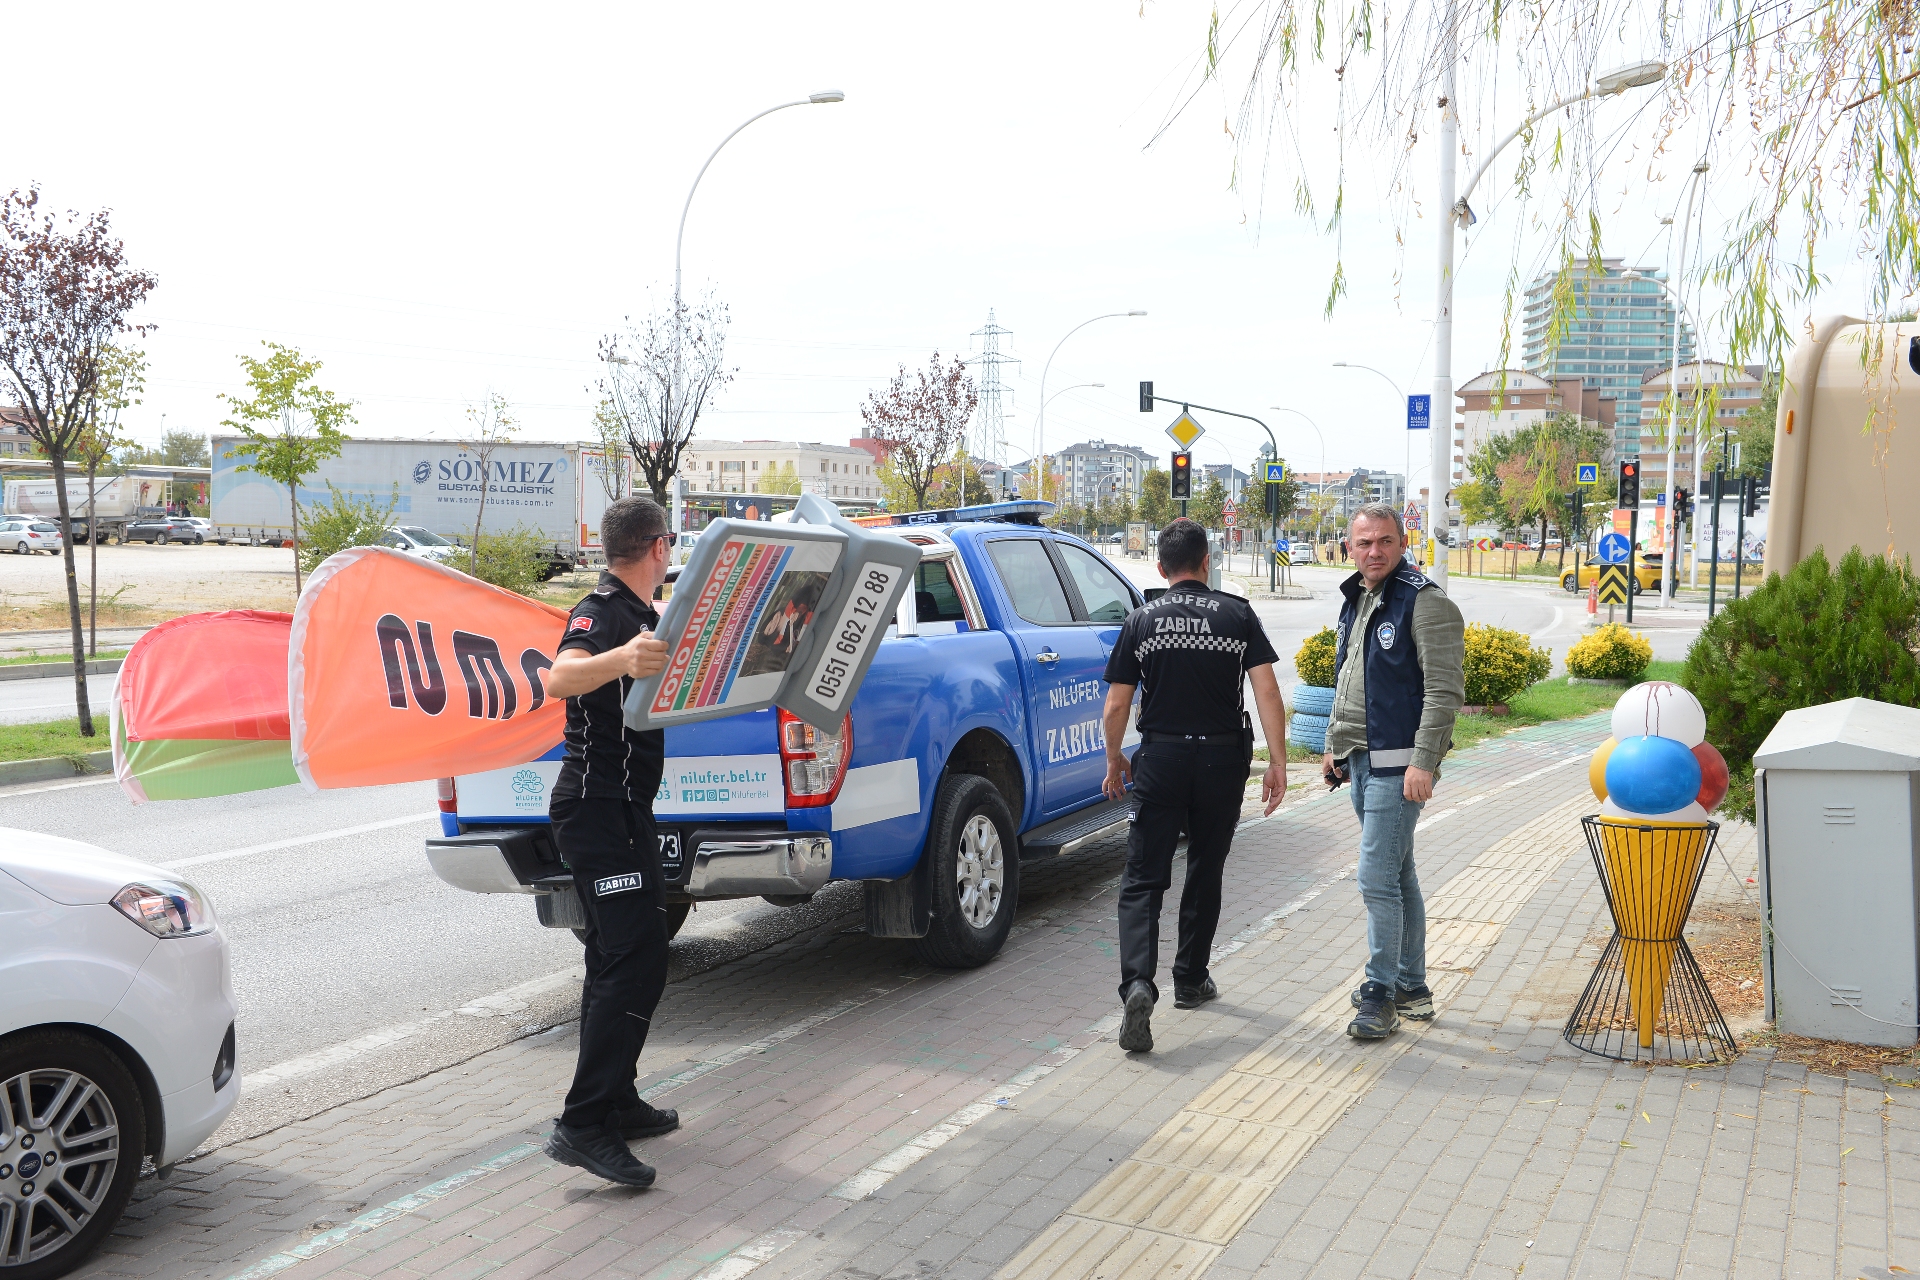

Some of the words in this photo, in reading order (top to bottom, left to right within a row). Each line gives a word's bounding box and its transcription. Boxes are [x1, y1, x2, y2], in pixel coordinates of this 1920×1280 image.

[438, 454, 555, 484] SÖNMEZ
[438, 496, 554, 507] www.sonmzbustas.com.tr
[500, 484, 554, 495] LOJİSTİK
[908, 514, 938, 524] CSR
[864, 570, 890, 594] 88
[854, 596, 878, 617] 12
[658, 646, 690, 708] FOTO
[686, 546, 738, 640] ULUDAĞ
[683, 634, 710, 688] VESİKALIK
[706, 624, 714, 632] &
[711, 566, 743, 621] BİOMETRİK
[732, 614, 750, 644] BASKI
[836, 620, 867, 655] 662
[1154, 617, 1212, 634] ZABITA
[714, 624, 734, 665] KAMERA
[816, 657, 850, 699] 0551
[1050, 678, 1100, 710] NİLÜFER
[1046, 718, 1106, 764] ZABITA
[680, 770, 767, 784] nilufer.bel.tr
[599, 876, 637, 892] ZABITA
